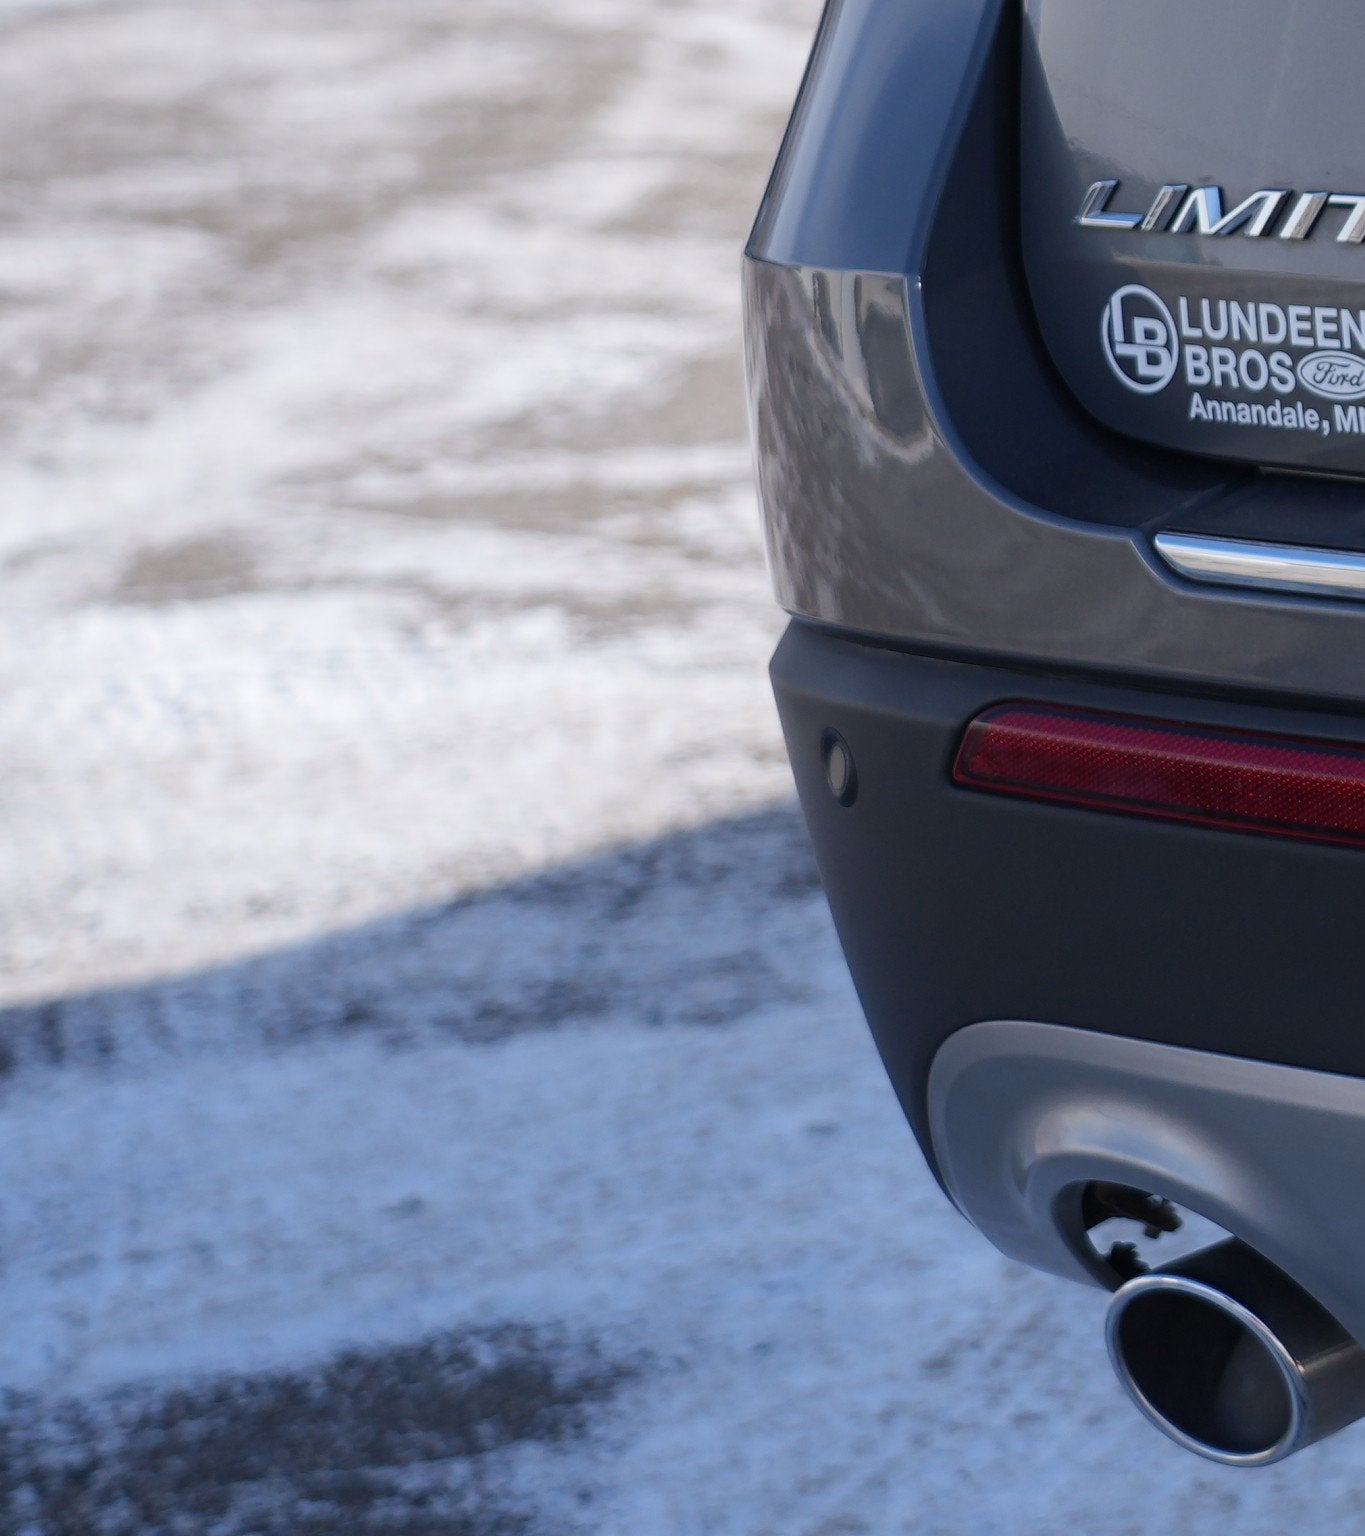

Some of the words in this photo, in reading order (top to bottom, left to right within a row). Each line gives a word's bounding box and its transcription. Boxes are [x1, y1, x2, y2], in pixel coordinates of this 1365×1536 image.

[1183, 343, 1297, 394] BROS
[1312, 361, 1365, 389] Ford
[1189, 391, 1331, 437] Annandale,
